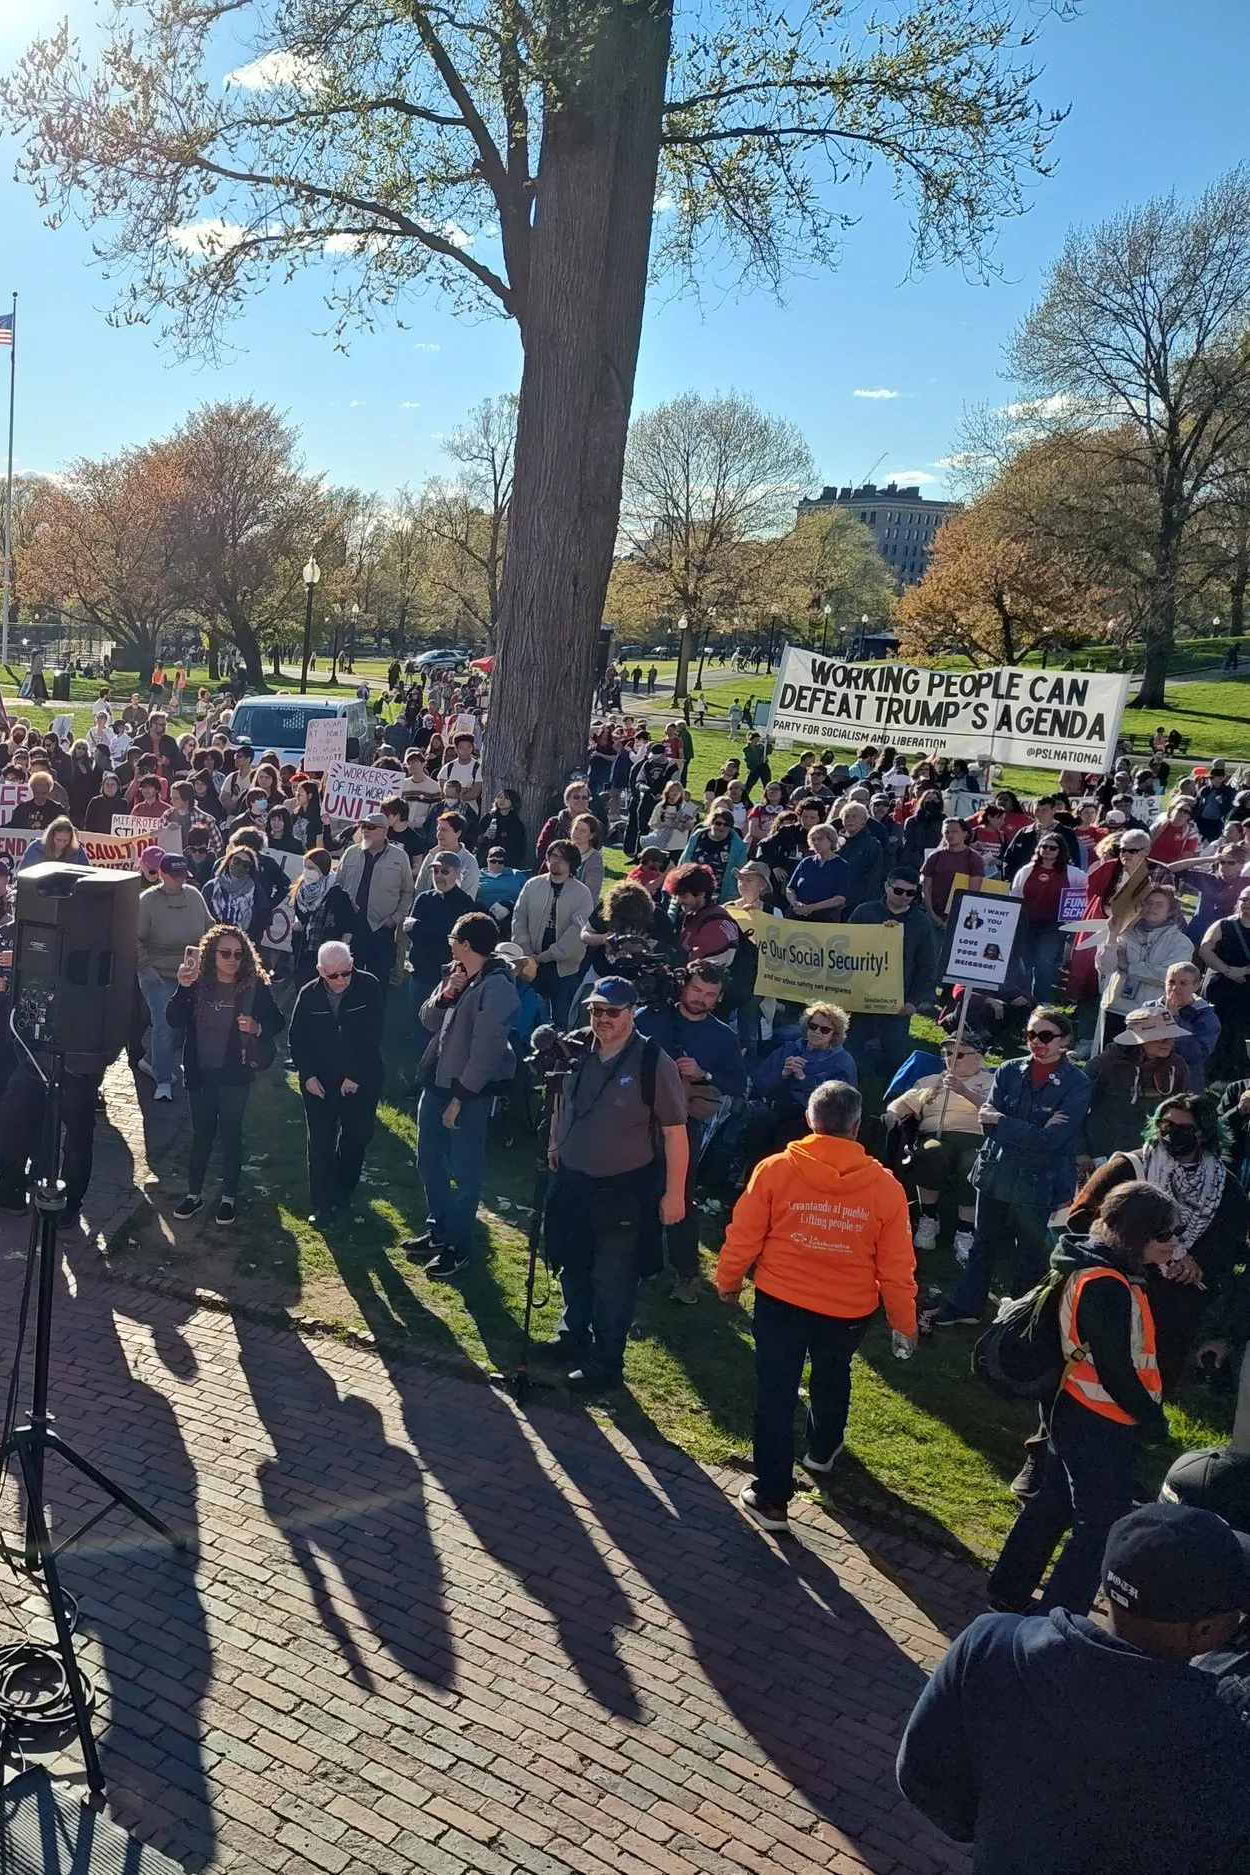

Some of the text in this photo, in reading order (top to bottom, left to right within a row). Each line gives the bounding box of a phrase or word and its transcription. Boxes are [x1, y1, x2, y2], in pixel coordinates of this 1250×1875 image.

[811, 658, 1089, 707] WORKING PEOPLE CAN
[778, 684, 1106, 742] DEFEAT TRUMP'S AGENDA
[773, 719, 946, 748] PARTY FOR SOCIALISM AND LIBERATION
[1026, 748, 1104, 765] @PSLNATIONAL
[344, 766, 389, 787] WORKERS
[332, 780, 345, 792] OF
[348, 782, 364, 795] THE
[324, 793, 387, 820] UNIT
[114, 816, 130, 825] MIT
[988, 909, 1010, 917] WANT
[756, 940, 889, 978] ve Our Social Security!
[764, 924, 854, 984] SOS
[782, 977, 796, 986] other
[797, 980, 814, 990] safety
[824, 986, 852, 995] programs
[832, 1202, 841, 1212] al
[842, 1206, 870, 1220] pueblo!
[800, 1213, 827, 1230] Lifting
[828, 1218, 854, 1232] people
